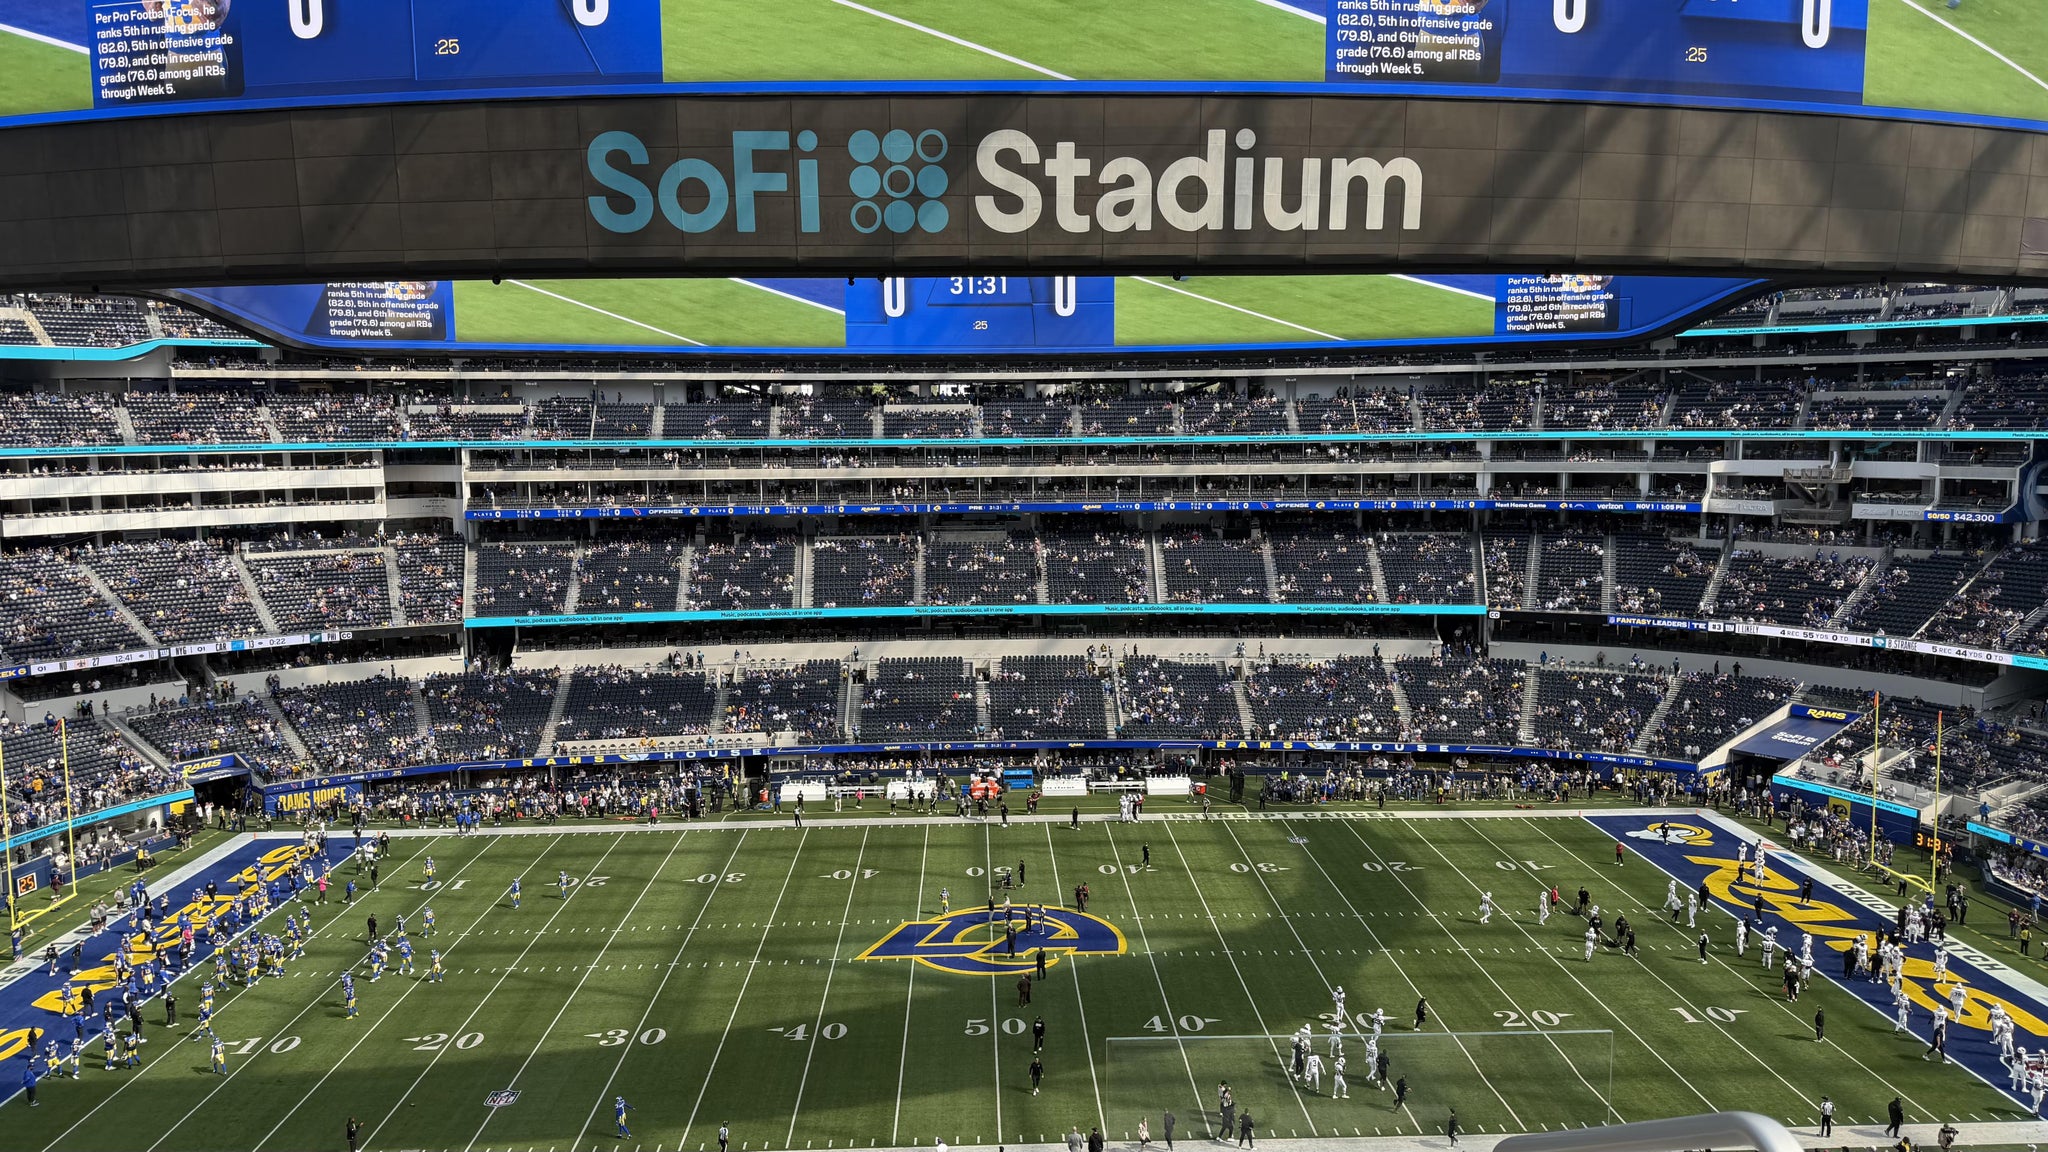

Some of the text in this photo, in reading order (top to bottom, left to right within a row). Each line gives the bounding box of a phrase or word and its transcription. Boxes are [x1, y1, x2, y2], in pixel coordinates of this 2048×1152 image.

[96, 5, 215, 24] Per Pro Football Focus, he
[1338, 0, 1474, 15] ranks 5th in rushing grade
[97, 21, 215, 39] ranks 5th in rushing grade
[1337, 14, 1492, 31] (82.6), 5th in offensive grade
[98, 34, 233, 54] (82.6), 5th in offensive grade
[1337, 30, 1479, 47] (79.8), and 6th in receiving
[435, 39, 459, 55] :25
[1337, 46, 1481, 62] grade (76.6) among all RBs
[1686, 47, 1707, 62] :25
[99, 51, 222, 69] (79.8), and 6th in receiving
[100, 66, 225, 86] grade (76.6) among all RBs
[1336, 63, 1424, 75] through Week 5.
[102, 84, 176, 99] through Week 5.
[588, 128, 1422, 234] SoFi Stadium
[950, 277, 1007, 294] 31:31
[330, 329, 360, 337] through
[973, 321, 988, 330] :25
[1954, 513, 1994, 521] $42,300
[1616, 617, 1687, 628] FANTASY LEADERS
[328, 633, 337, 641] PHI
[175, 646, 186, 655] NYG
[216, 643, 227, 652] CAR
[248, 641, 255, 649] 13
[1894, 641, 1917, 651] STRANGE
[92, 654, 133, 667] 27 12:41
[1955, 649, 1967, 657] 44
[1807, 708, 1846, 720] RAMS
[1351, 744, 1449, 752] HOUSE
[523, 748, 761, 766] RAMS HOUSE
[183, 759, 222, 774] RAMS
[279, 786, 347, 811] RAMS HOUSE
[1230, 862, 1278, 873] 30
[1362, 861, 1412, 872] 20
[1495, 860, 1544, 871] 10
[695, 872, 746, 884] 30
[832, 867, 880, 881] 40
[20, 876, 34, 892] 25
[1492, 1010, 1562, 1027] 20
[1669, 1005, 1738, 1024] 10
[964, 1017, 1027, 1036] 50
[1142, 1014, 1206, 1033] 40
[599, 1027, 667, 1047] 30
[784, 1022, 848, 1041] 40
[230, 1036, 302, 1055] 10
[413, 1032, 485, 1051] 20
